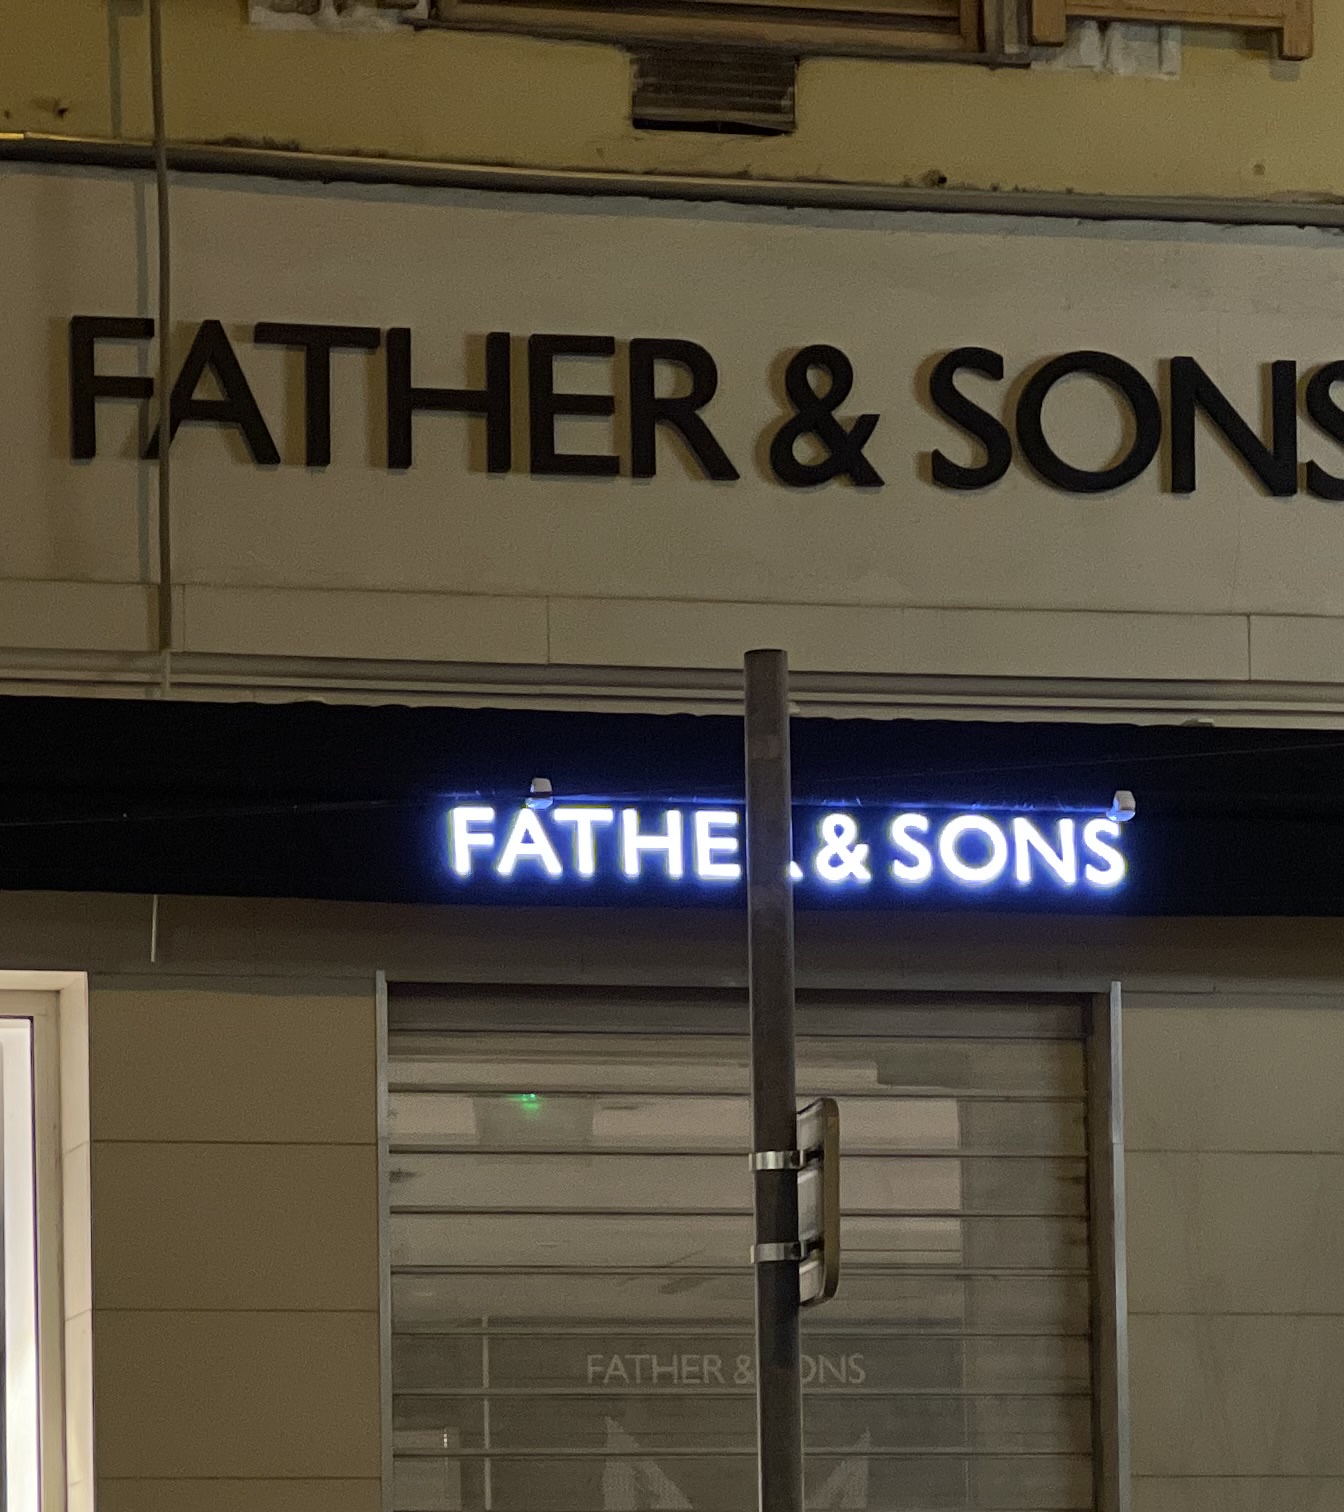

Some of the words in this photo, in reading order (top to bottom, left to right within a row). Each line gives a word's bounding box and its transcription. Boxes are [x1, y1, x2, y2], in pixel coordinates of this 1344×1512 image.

[68, 316, 740, 481] FATHER
[769, 345, 885, 488] &
[451, 805, 803, 881] FATHE
[815, 813, 871, 884] &
[890, 814, 1127, 889] SONS
[587, 1354, 725, 1384] FATHER
[733, 1354, 756, 1384] &
[800, 1353, 866, 1384] ONS
